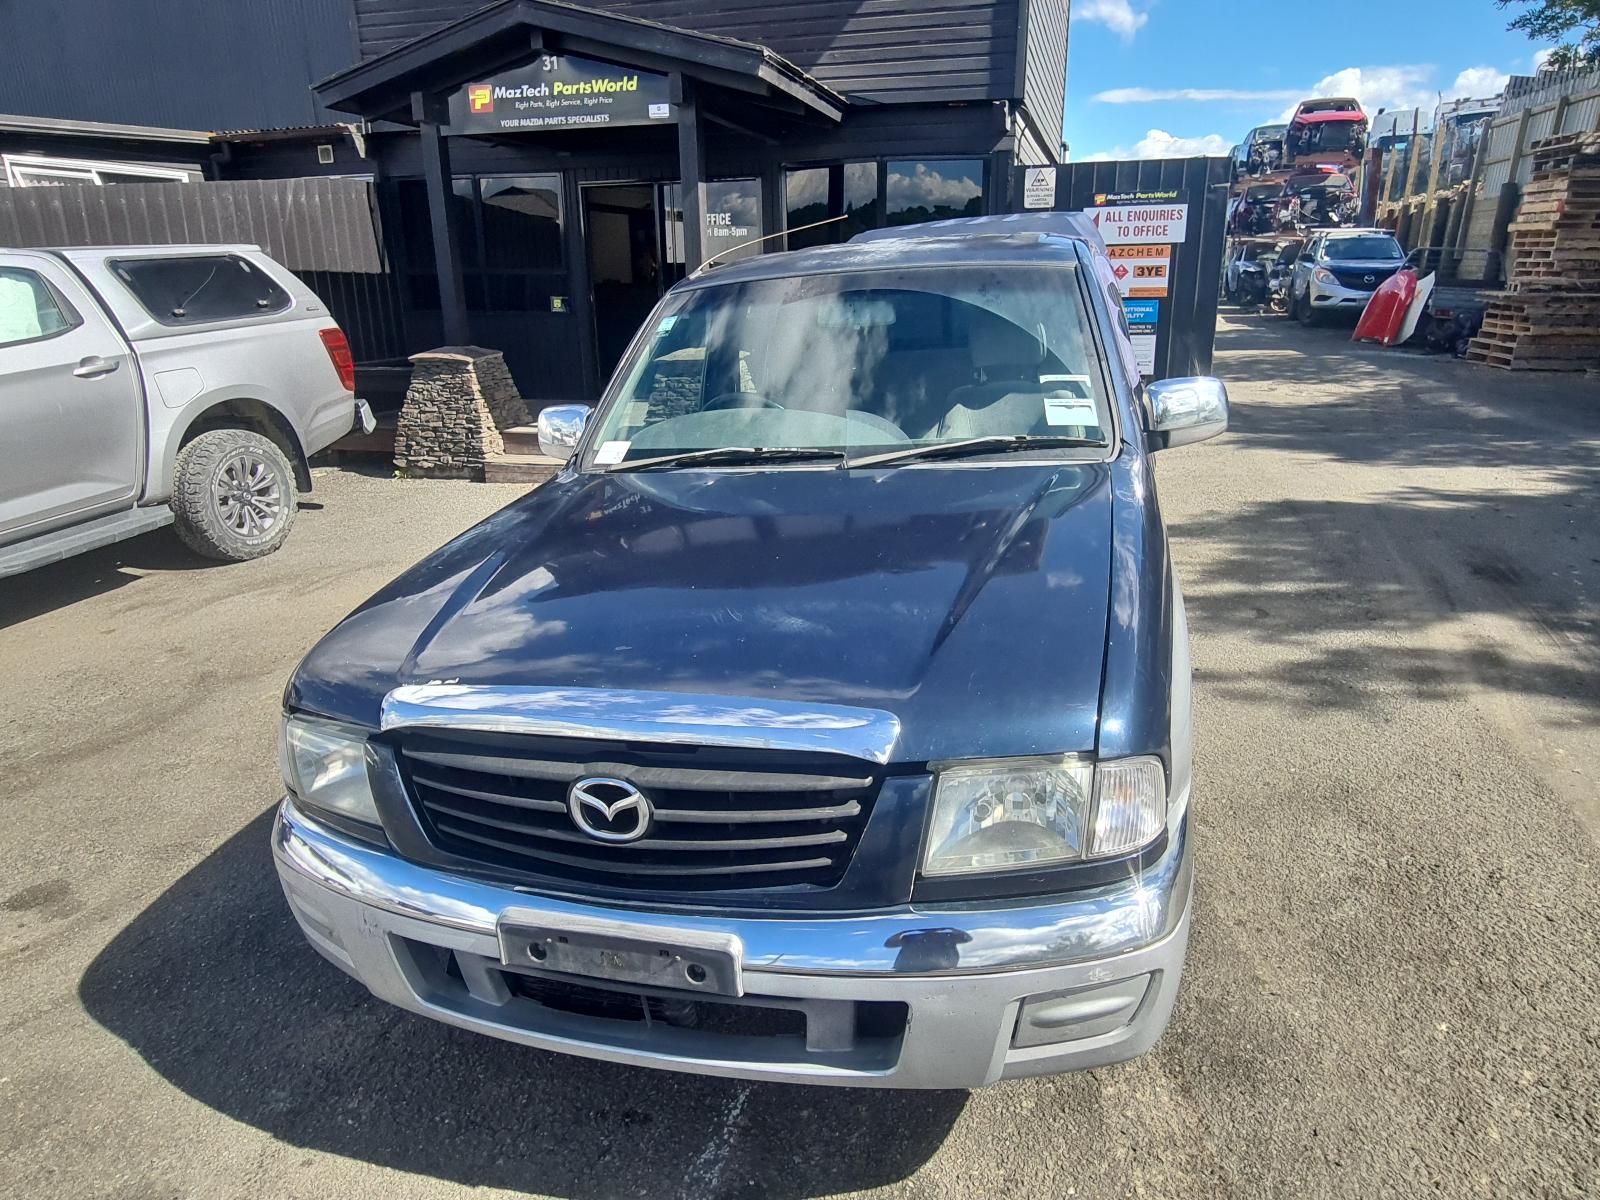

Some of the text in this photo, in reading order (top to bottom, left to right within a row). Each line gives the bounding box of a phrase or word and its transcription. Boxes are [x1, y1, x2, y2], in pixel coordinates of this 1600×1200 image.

[542, 55, 558, 71] 31
[494, 75, 638, 99] MazTech PartsWorld
[515, 101, 529, 110] Right
[546, 99, 560, 109] Right
[583, 97, 598, 107] Right
[599, 96, 613, 104] Price
[500, 114, 610, 128] YOUR MAZDA PARTS SPECIALISTS
[1135, 190, 1178, 199] PartsWorld
[706, 213, 732, 226] FFICE
[1104, 209, 1184, 223] ALL ENQUIRIES
[1117, 224, 1169, 237] TO OFFICE
[1110, 247, 1164, 257] AZCHEM
[1136, 266, 1163, 277] 3YE
